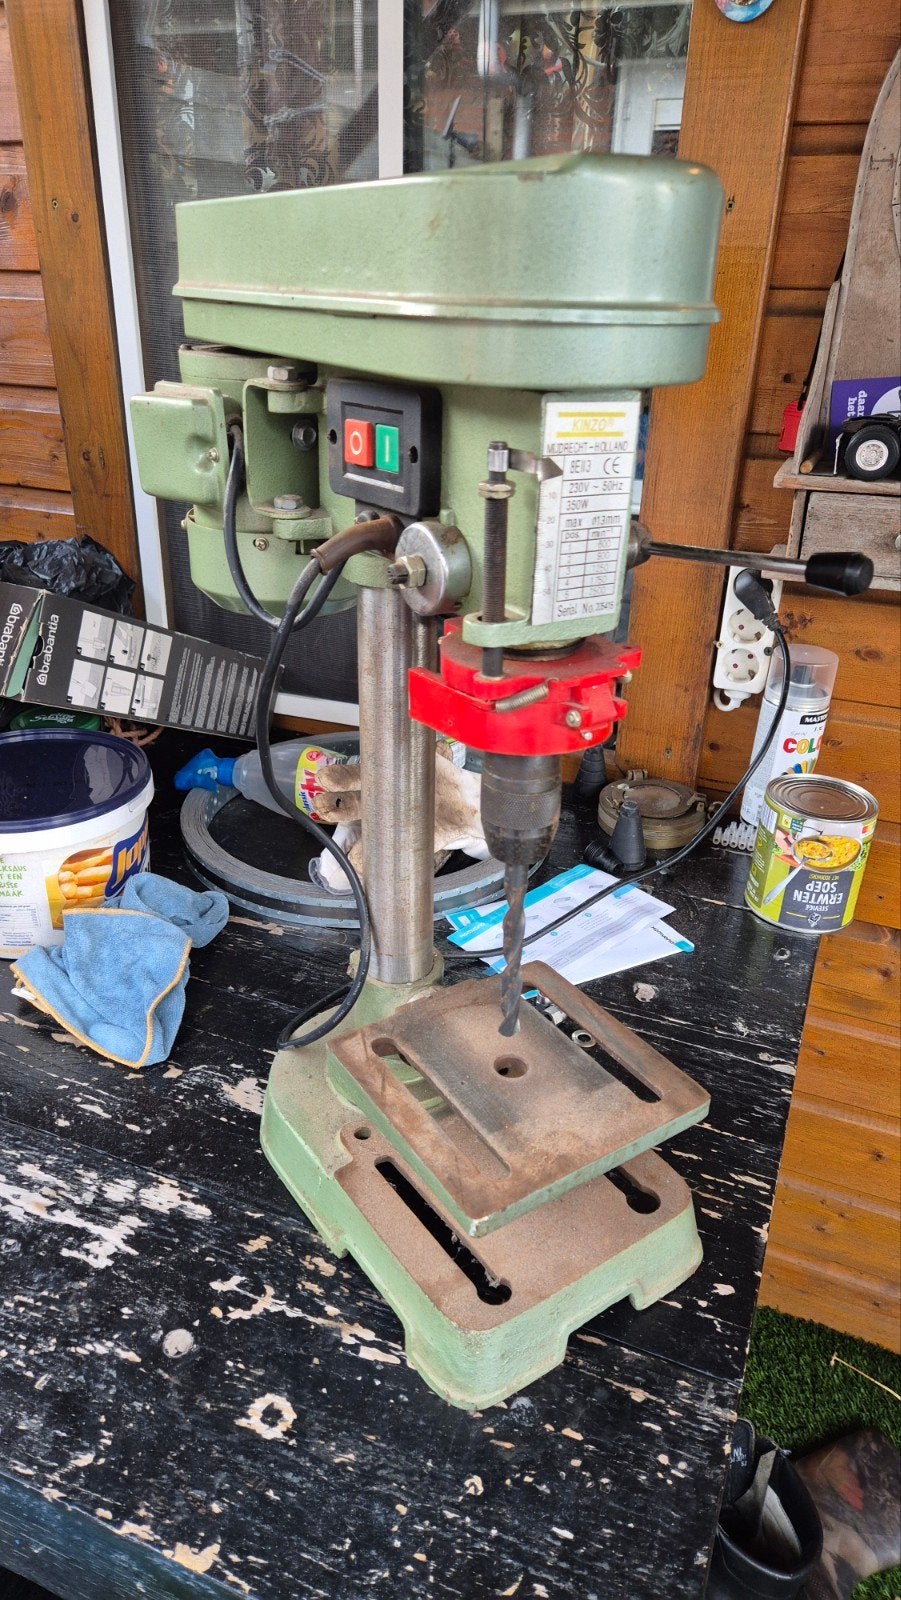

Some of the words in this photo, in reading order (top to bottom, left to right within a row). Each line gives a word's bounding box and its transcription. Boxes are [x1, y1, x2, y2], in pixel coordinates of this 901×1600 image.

[847, 396, 857, 417] het
[603, 456, 620, 475] CE
[569, 481, 590, 494] 230V
[602, 480, 623, 492] 50Hz
[566, 499, 589, 511] 350W
[566, 518, 582, 528] max
[0, 614, 21, 667] brabant
[38, 614, 60, 674] brabantia
[805, 880, 838, 893] SOEP
[793, 889, 844, 905] ERWTEN
